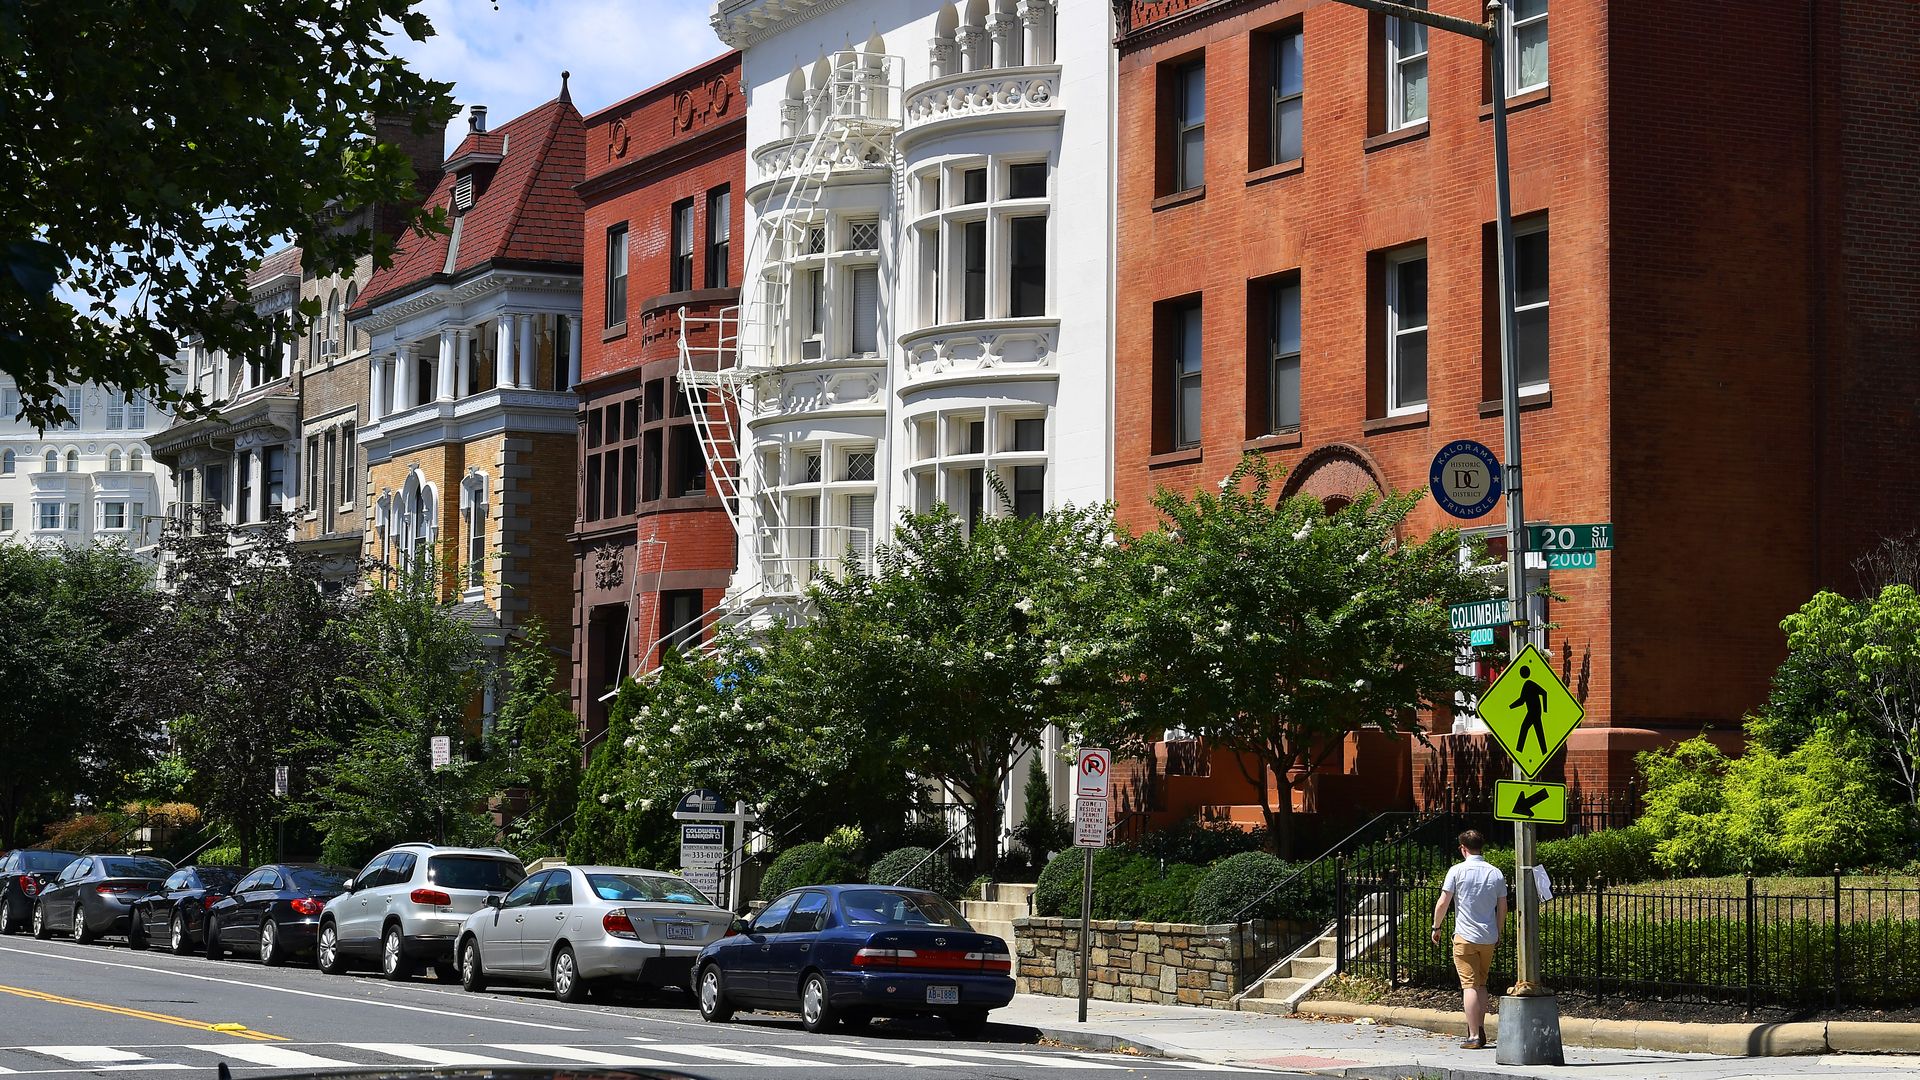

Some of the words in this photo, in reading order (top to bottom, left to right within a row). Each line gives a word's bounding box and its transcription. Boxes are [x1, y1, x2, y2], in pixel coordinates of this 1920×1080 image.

[1438, 444, 1493, 465] KALORAMA
[1453, 470, 1480, 489] DC
[1443, 496, 1494, 515] TRIANGLE
[1541, 528, 1576, 550] 20
[1591, 526, 1607, 537] ST
[1591, 537, 1608, 548] NW
[1549, 552, 1593, 567] 2000
[1451, 602, 1501, 629] COLUMBIA
[1471, 628, 1493, 643] 2000
[692, 851, 723, 859] 333-6100
